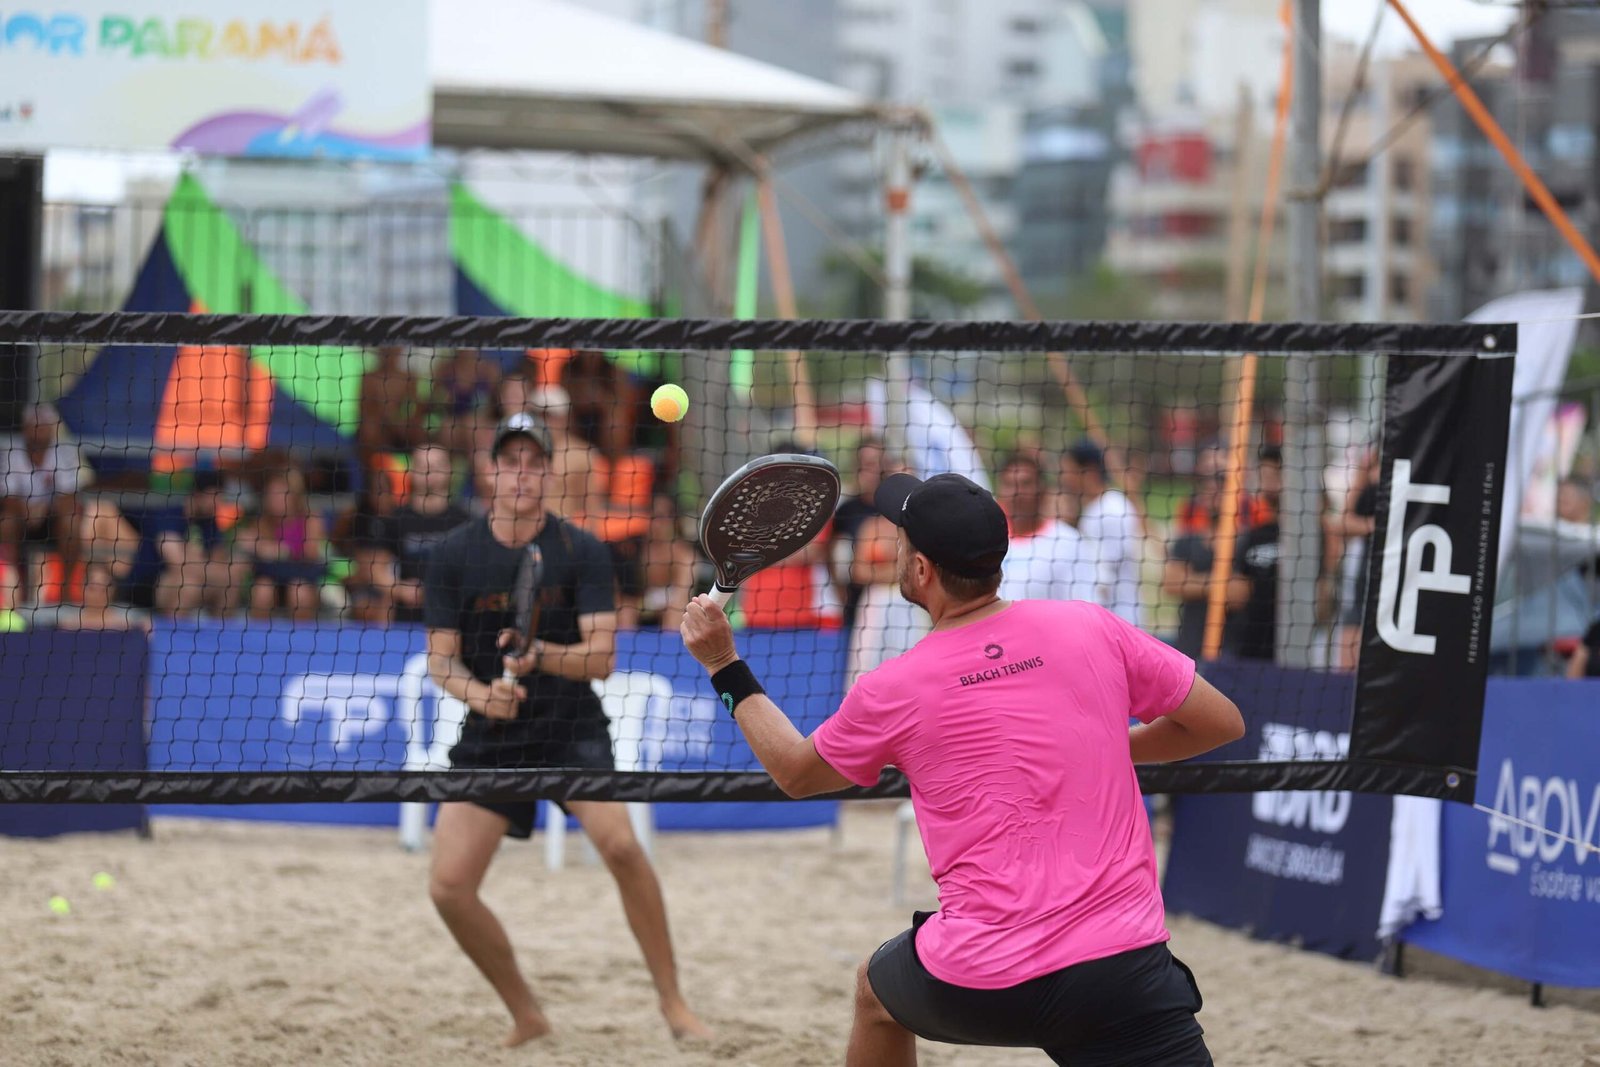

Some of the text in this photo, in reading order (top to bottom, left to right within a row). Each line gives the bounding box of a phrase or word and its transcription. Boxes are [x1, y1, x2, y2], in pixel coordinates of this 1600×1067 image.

[0, 13, 86, 55] OR
[1482, 499, 1492, 515] DE
[960, 656, 1044, 686] BEACH TENNIS
[1487, 757, 1600, 866] ABOV
